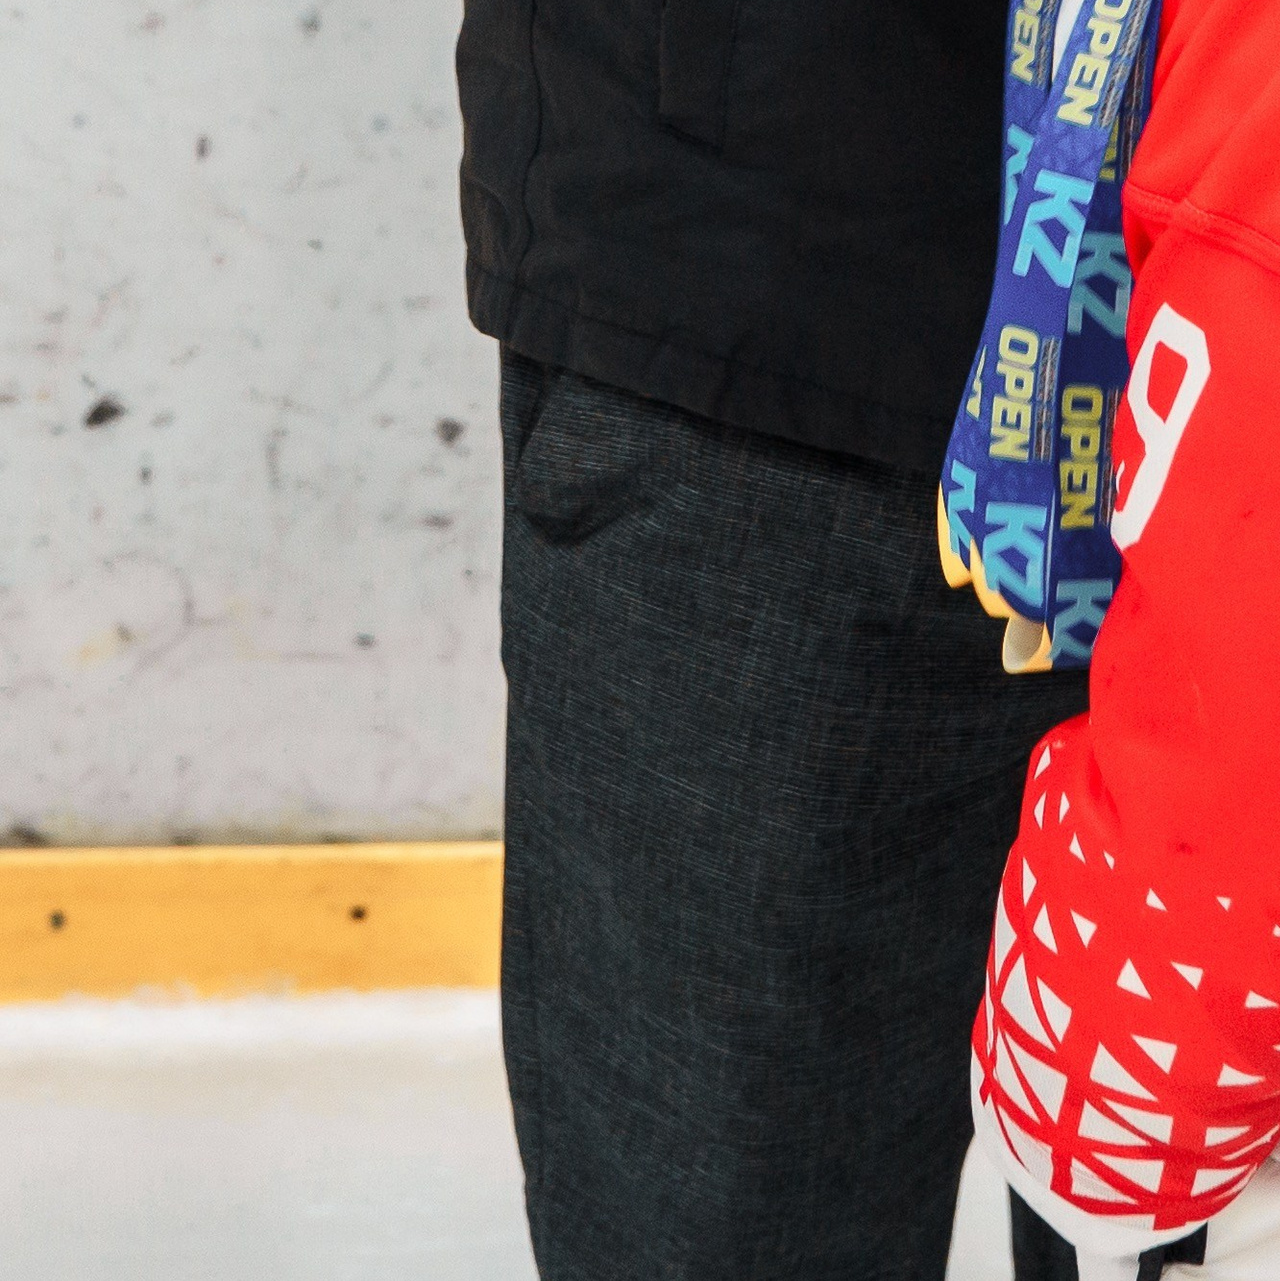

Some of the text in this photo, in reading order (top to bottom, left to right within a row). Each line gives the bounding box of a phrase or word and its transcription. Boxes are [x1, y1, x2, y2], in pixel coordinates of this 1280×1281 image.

[1013, 169, 1095, 289] KZ
[989, 326, 1039, 462] OPEN
[1060, 384, 1103, 532] OPEN
[1111, 302, 1212, 552] 9
[983, 502, 1047, 609] KZ
